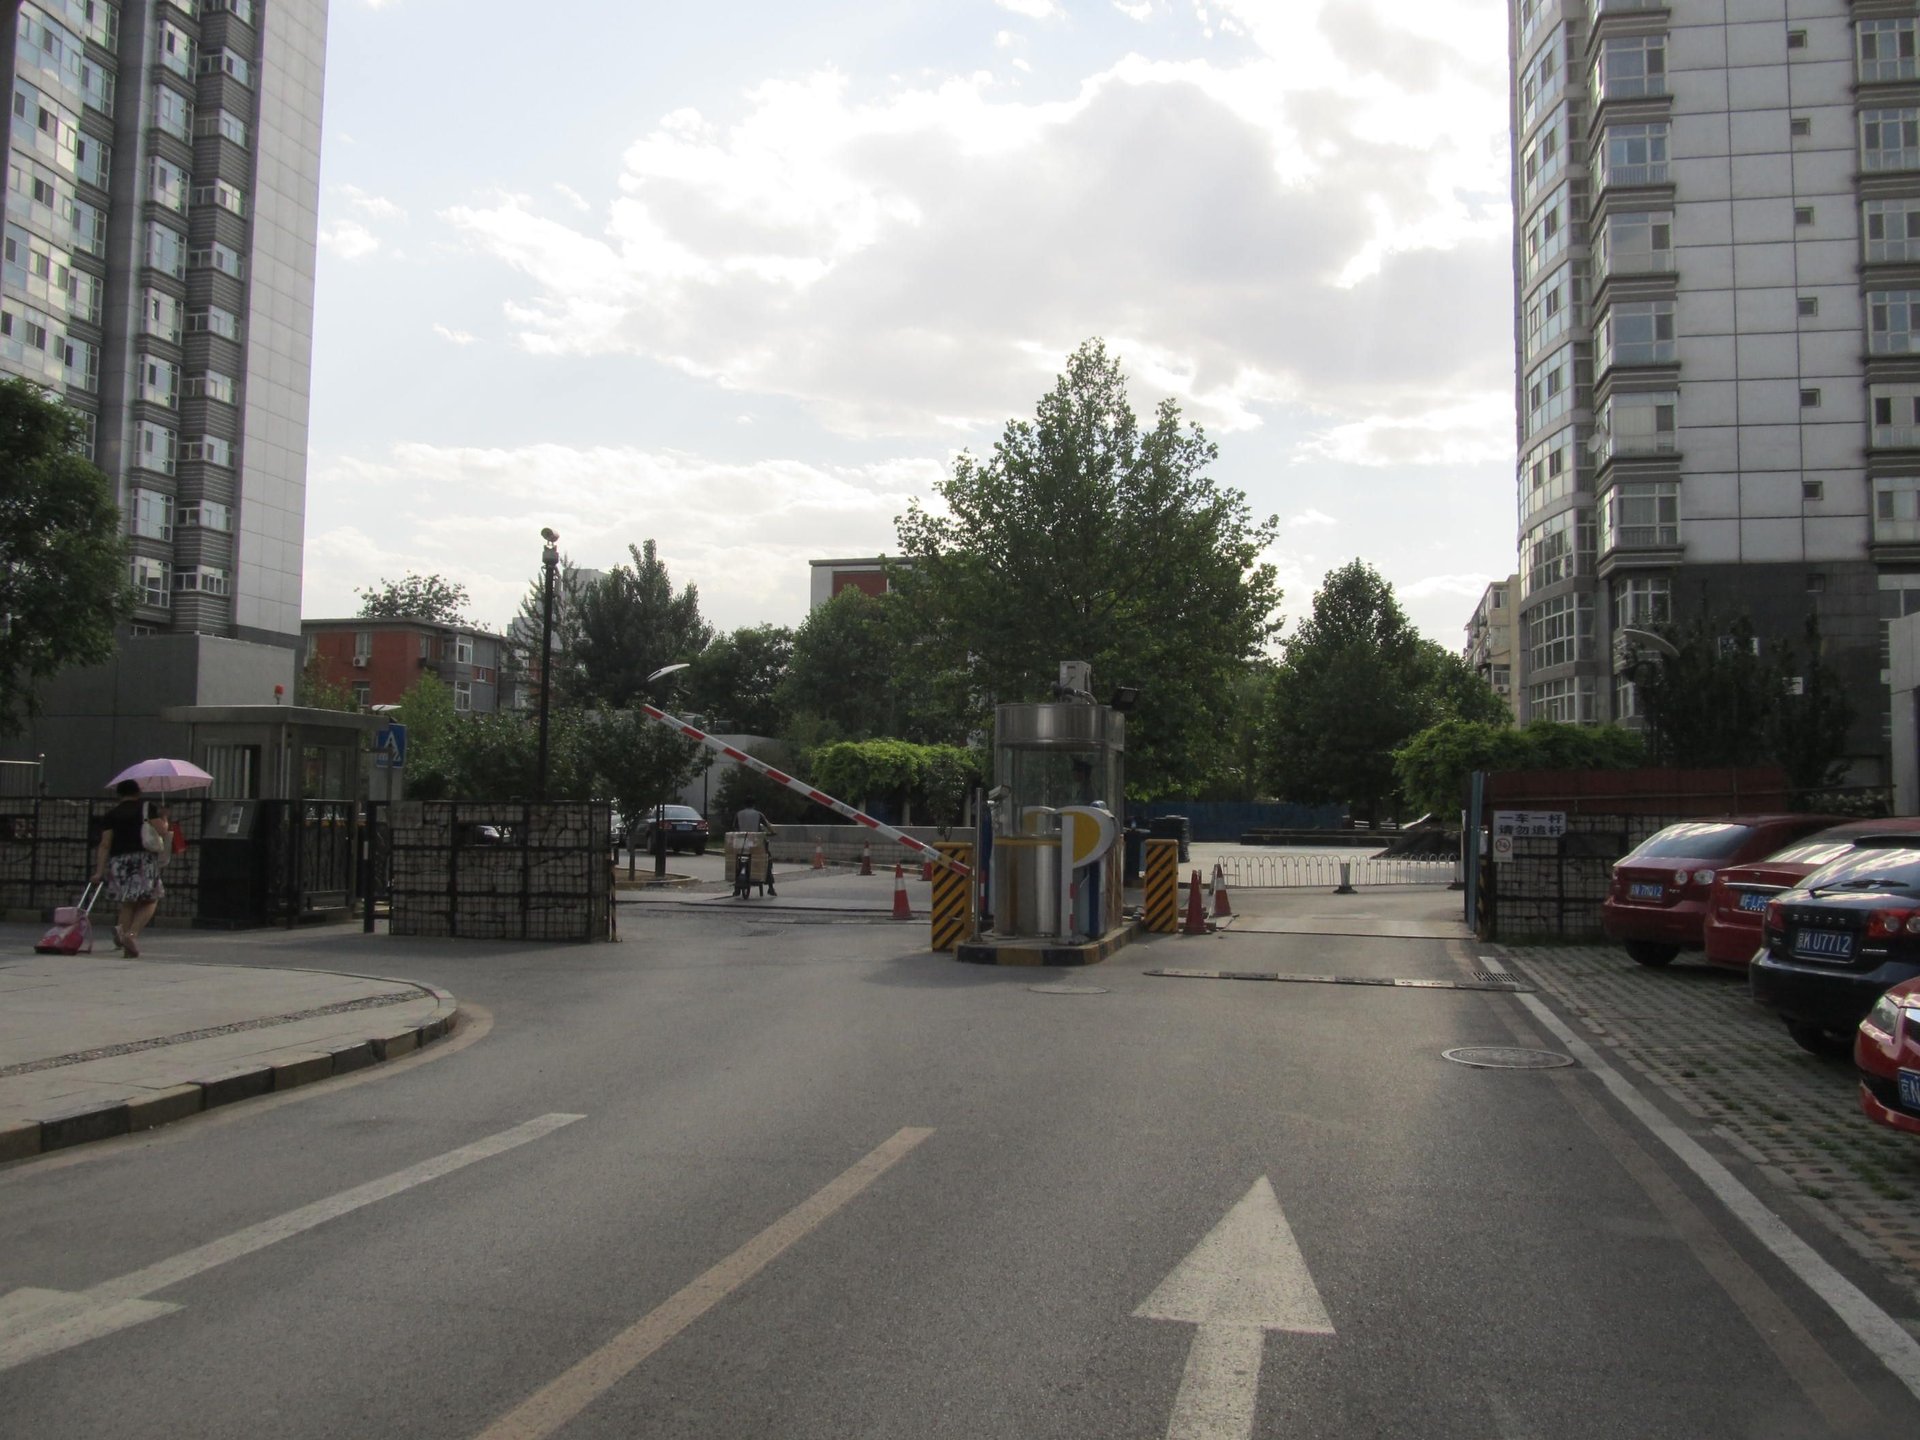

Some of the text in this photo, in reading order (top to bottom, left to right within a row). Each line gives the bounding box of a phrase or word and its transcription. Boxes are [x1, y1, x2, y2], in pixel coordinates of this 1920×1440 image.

[1498, 813, 1563, 824] 一车一杆
[1498, 824, 1563, 835] 请勿追杆
